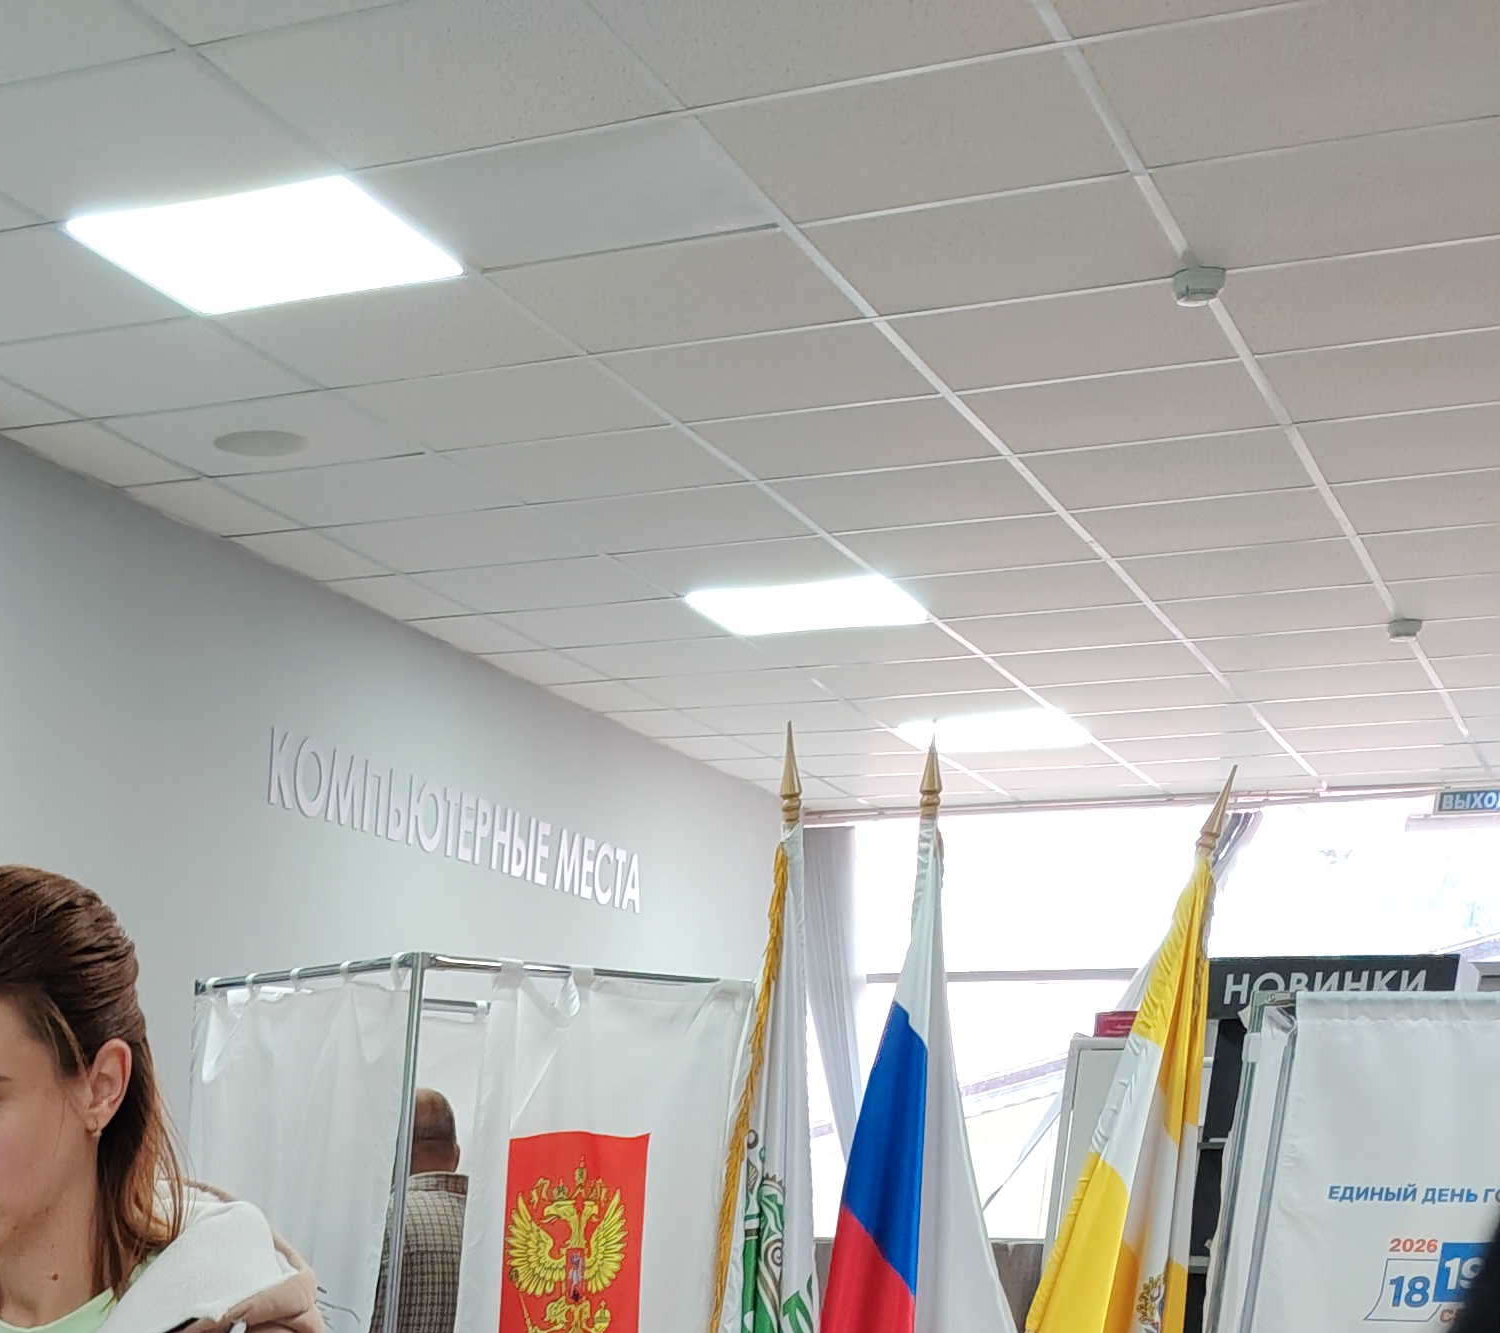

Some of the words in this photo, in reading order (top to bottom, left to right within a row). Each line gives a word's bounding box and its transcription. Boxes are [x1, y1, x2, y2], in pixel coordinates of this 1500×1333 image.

[267, 725, 551, 887] КОМПЬЮТЕРНЫЕ
[555, 828, 641, 913] МЕСТА
[1328, 1183, 1418, 1204] ЕДИНЫЙ
[1421, 1187, 1478, 1205] ДЕНЬ
[1389, 1238, 1438, 1253] 2026
[1389, 1275, 1431, 1308] 18
